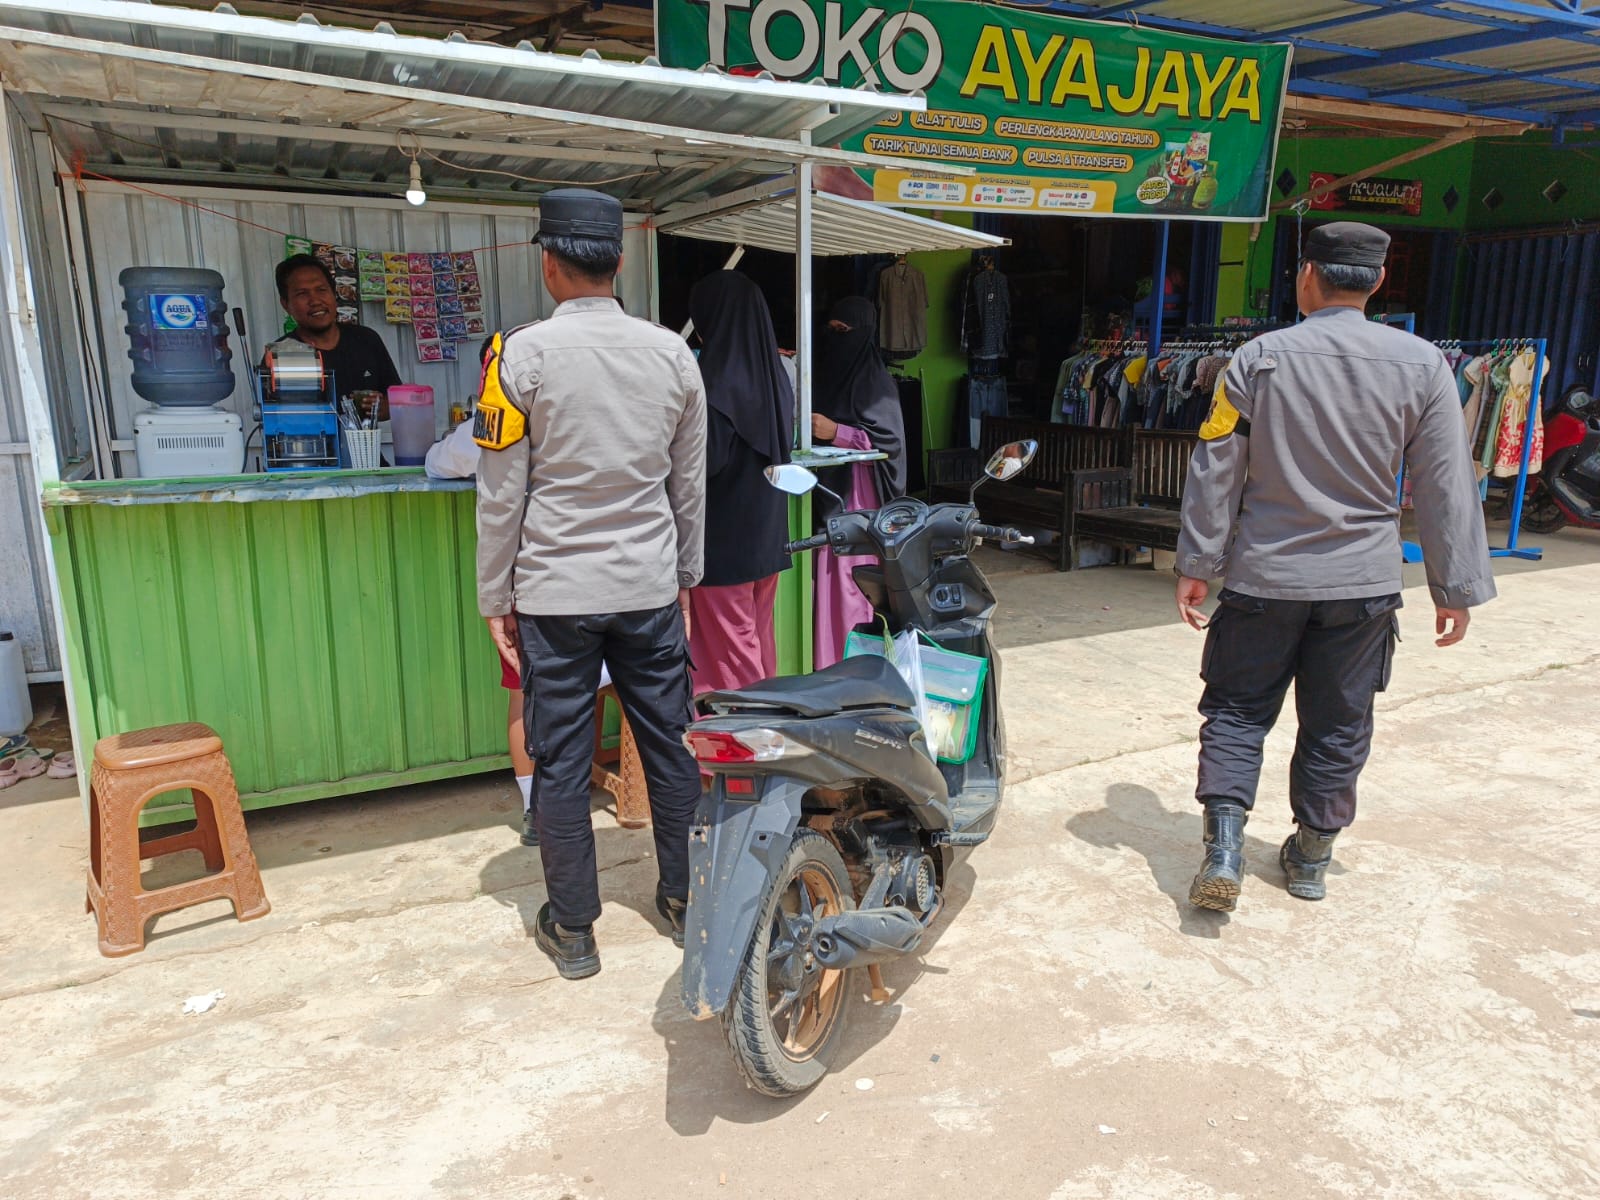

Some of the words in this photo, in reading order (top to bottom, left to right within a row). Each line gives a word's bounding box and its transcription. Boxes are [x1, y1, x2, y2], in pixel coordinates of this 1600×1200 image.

[692, 0, 943, 91] TOKO
[959, 24, 1104, 111] AYA
[1106, 46, 1261, 121] JAYA
[917, 112, 947, 128] ALAT
[949, 115, 982, 130] TULIS
[1000, 121, 1085, 139] PERLENGKAPAN
[1085, 127, 1118, 142] ULANG
[1119, 131, 1154, 145] TAHUN
[870, 138, 906, 153] TARIK
[907, 141, 941, 156] TUNAI
[942, 145, 980, 159] SEMUA
[981, 148, 1013, 162] BANK
[1028, 151, 1063, 165] PULSA
[1064, 155, 1071, 165] &
[1072, 154, 1128, 169] TRANSFER
[166, 303, 193, 314] AQUA
